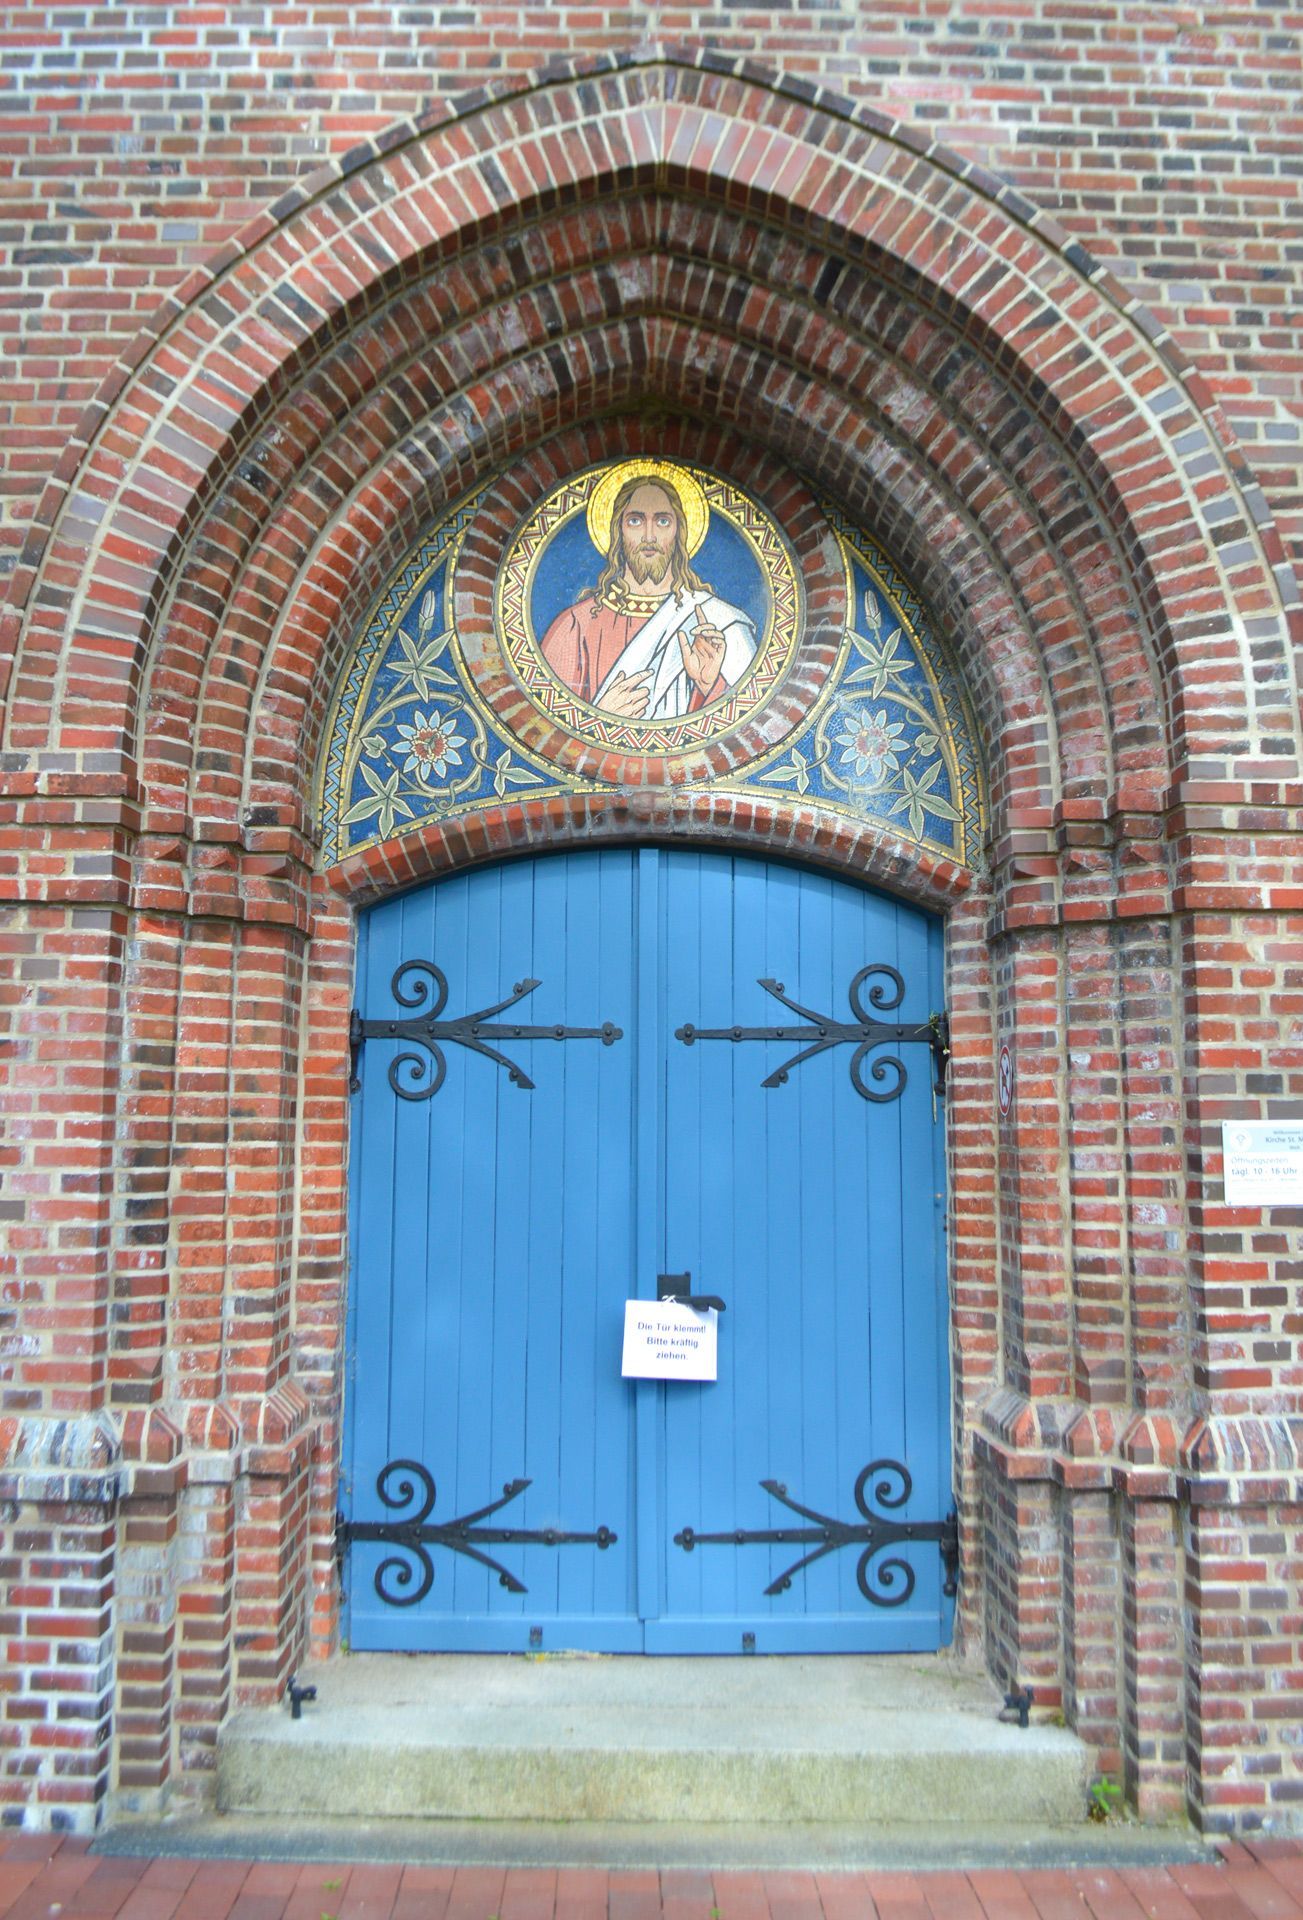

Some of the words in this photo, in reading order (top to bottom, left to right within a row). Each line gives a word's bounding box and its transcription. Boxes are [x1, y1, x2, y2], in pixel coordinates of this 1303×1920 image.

[1253, 1167, 1263, 1175] 10
[1282, 1167, 1298, 1175] Uhr
[637, 1321, 653, 1330] Die
[656, 1322, 671, 1332] Tür
[673, 1324, 706, 1334] klemmt!
[646, 1336, 668, 1346] Bitte
[670, 1338, 699, 1349] kräftig
[656, 1351, 689, 1360] ziehen.
